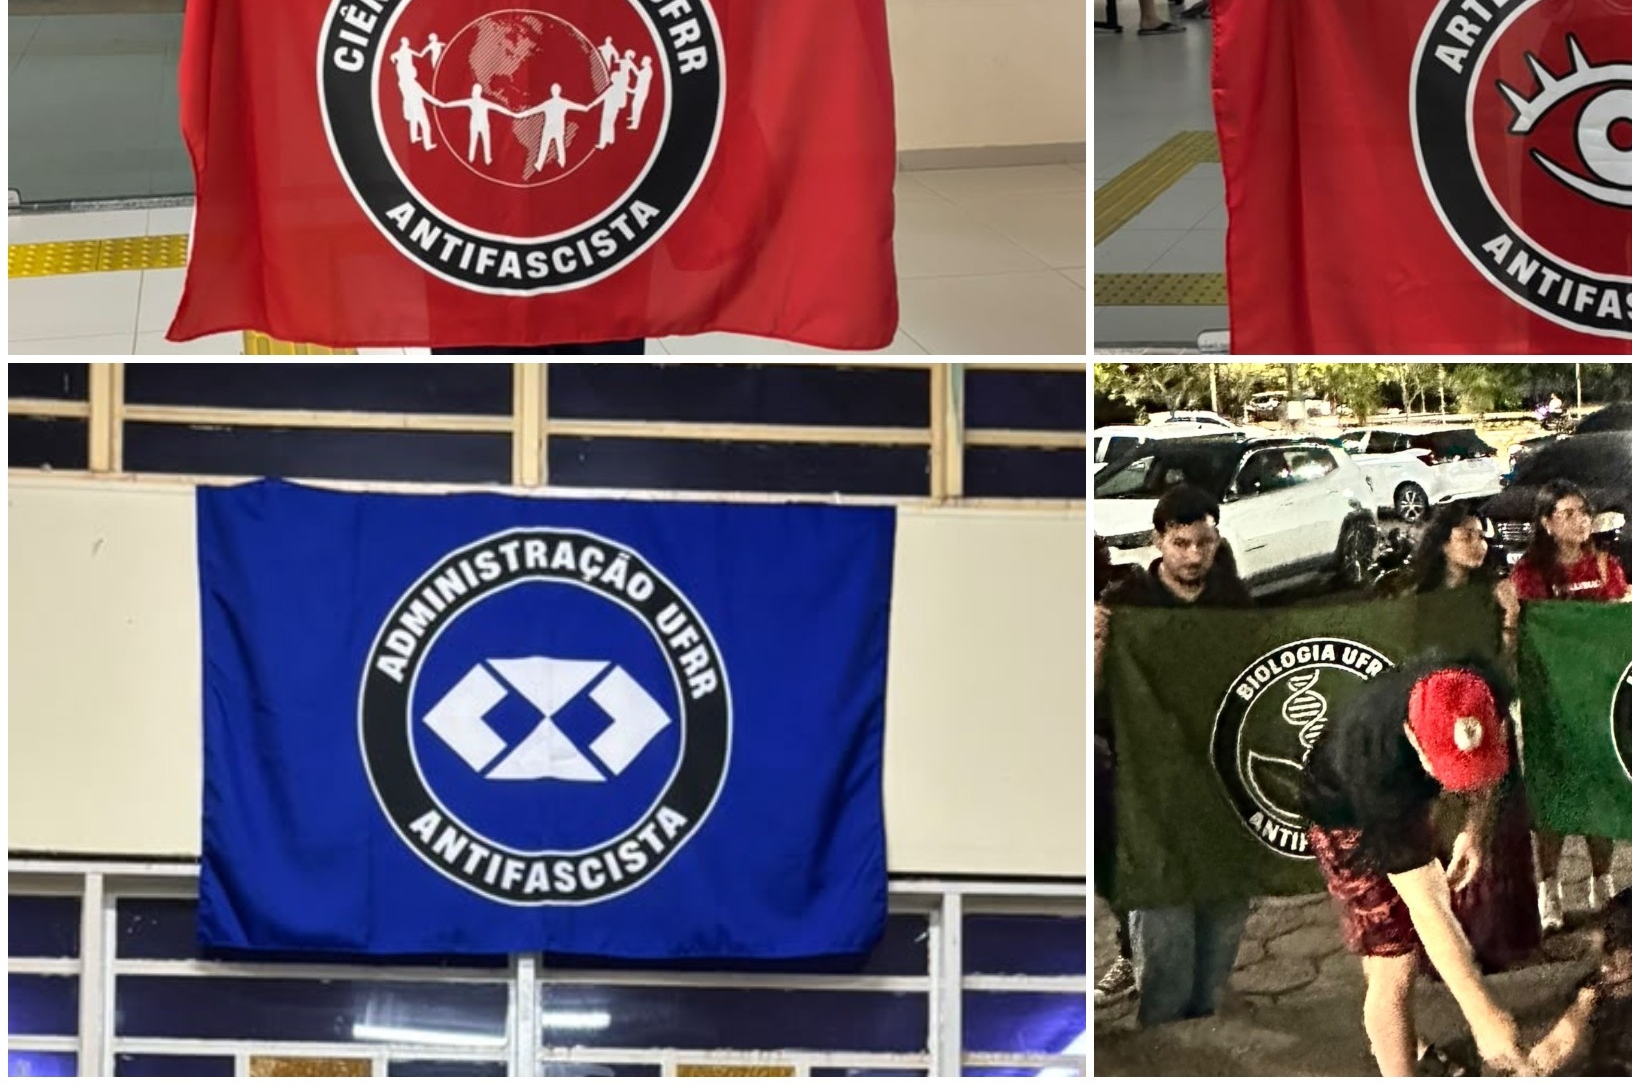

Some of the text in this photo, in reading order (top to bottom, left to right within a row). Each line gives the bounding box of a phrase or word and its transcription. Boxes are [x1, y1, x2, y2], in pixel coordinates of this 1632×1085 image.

[386, 200, 661, 279] ANTIFASCISTA
[376, 539, 719, 700] ADMINISTRAÇÃO UFRR
[1236, 644, 1384, 701] BIOLOGIA UFR
[409, 805, 688, 894] ANTIFASCISTA
